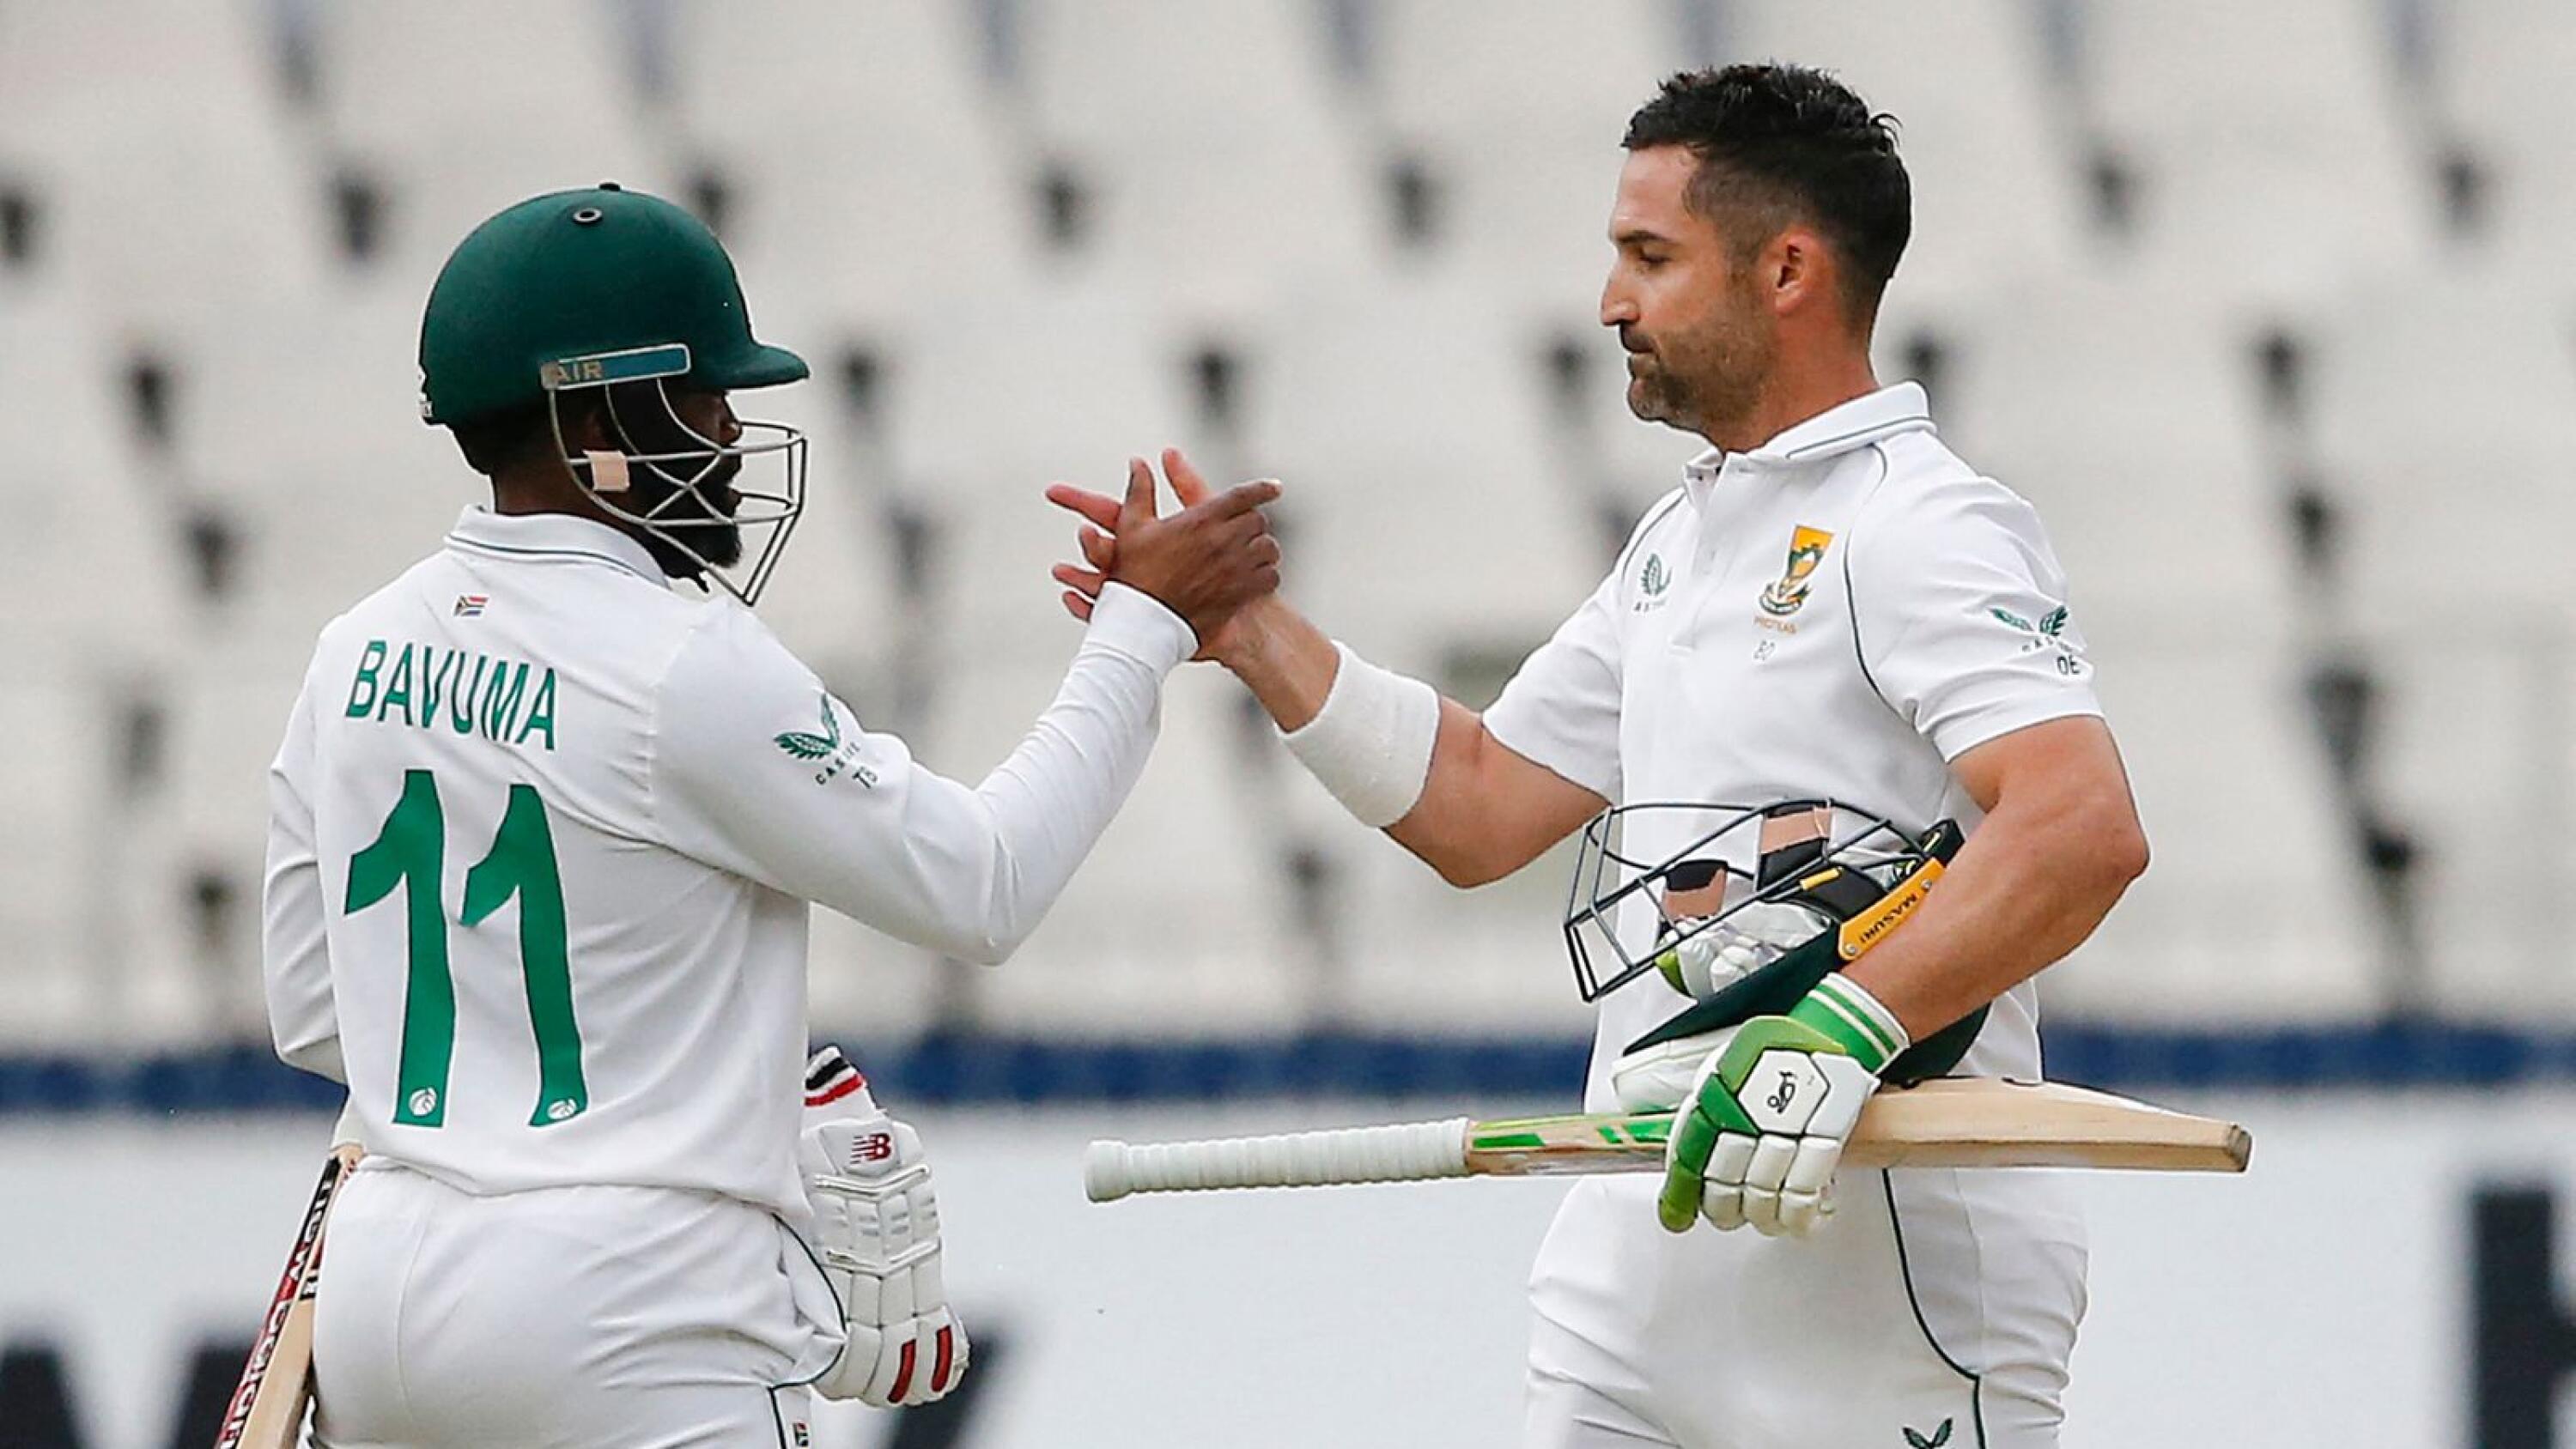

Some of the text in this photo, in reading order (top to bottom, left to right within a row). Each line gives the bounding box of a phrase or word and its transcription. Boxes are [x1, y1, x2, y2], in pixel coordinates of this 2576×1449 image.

[345, 640, 556, 751] BAVUMA
[344, 769, 587, 1127] 11
[1860, 893, 1917, 943] MASURI
